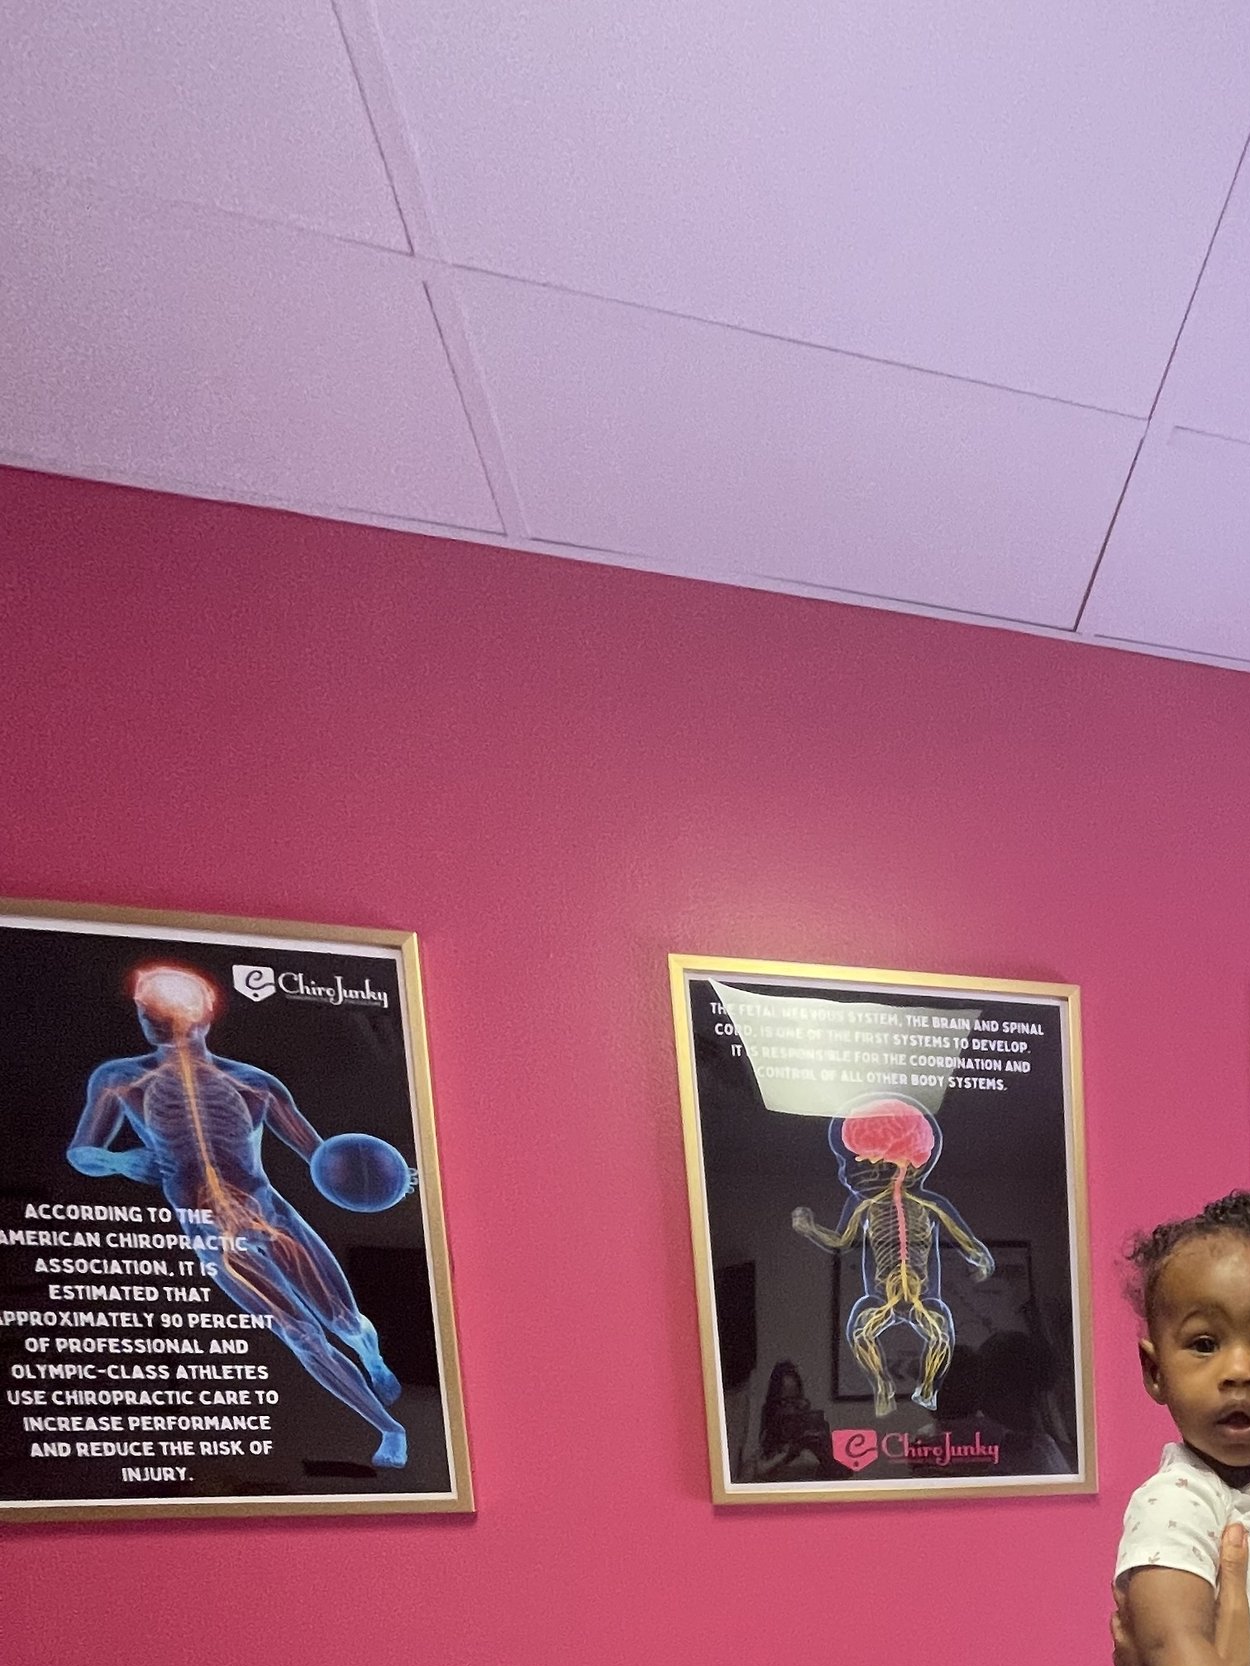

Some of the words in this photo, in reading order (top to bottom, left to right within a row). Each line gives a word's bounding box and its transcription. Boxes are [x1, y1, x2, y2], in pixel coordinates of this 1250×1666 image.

[278, 972, 389, 1009] ChiroJunky
[906, 1015, 930, 1028] THE
[932, 1016, 971, 1031] BRAIN
[974, 1020, 999, 1032] AND
[1002, 1021, 1045, 1036] SPINAL
[855, 1031, 890, 1045] FIRST
[894, 1033, 951, 1049] SYSTEMS
[953, 1037, 969, 1050] TO
[972, 1038, 1032, 1054] DEVELOP.
[731, 1044, 743, 1057] IT
[855, 1050, 880, 1065] FOR
[883, 1053, 907, 1066] THE
[909, 1054, 1002, 1071] COORDINATION
[1005, 1060, 1031, 1073] AND
[821, 1069, 837, 1081] OF
[840, 1070, 863, 1083] ALL
[867, 1072, 908, 1085] OTHER
[911, 1073, 945, 1087] BODY
[25, 1203, 143, 1222] ACCORDING
[147, 1207, 172, 1223] TO
[177, 1208, 214, 1225] THE
[0, 1229, 101, 1247] AMERICAN
[105, 1232, 248, 1251] CHIROPRACTIC
[179, 1260, 195, 1276] IT
[201, 1262, 218, 1277] IS
[49, 1284, 159, 1301] ESTIMATED
[163, 1286, 211, 1302] THAT
[160, 1313, 183, 1328] 90
[188, 1313, 274, 1329] PERCENT
[25, 1337, 50, 1353] OF
[55, 1337, 205, 1354] PROFESSIONAL
[209, 1339, 249, 1354] AND
[11, 1364, 170, 1380] OLYMPIC-CLASS
[176, 1365, 269, 1380] ATHLETES
[6, 1390, 48, 1405] USE
[51, 1389, 194, 1406] CHIROPRACTIC
[199, 1390, 252, 1405] CARE
[255, 1390, 279, 1405] TO
[23, 1416, 124, 1432] INCREASE
[128, 1415, 272, 1431] PERFORMANCE
[30, 1442, 71, 1457] AND
[76, 1441, 155, 1457] REDUCE
[158, 1441, 195, 1456] THE
[200, 1440, 245, 1455] RISK
[249, 1440, 273, 1455] OF
[881, 1431, 999, 1466] ChiroJunky
[122, 1467, 195, 1482] INJURY.
